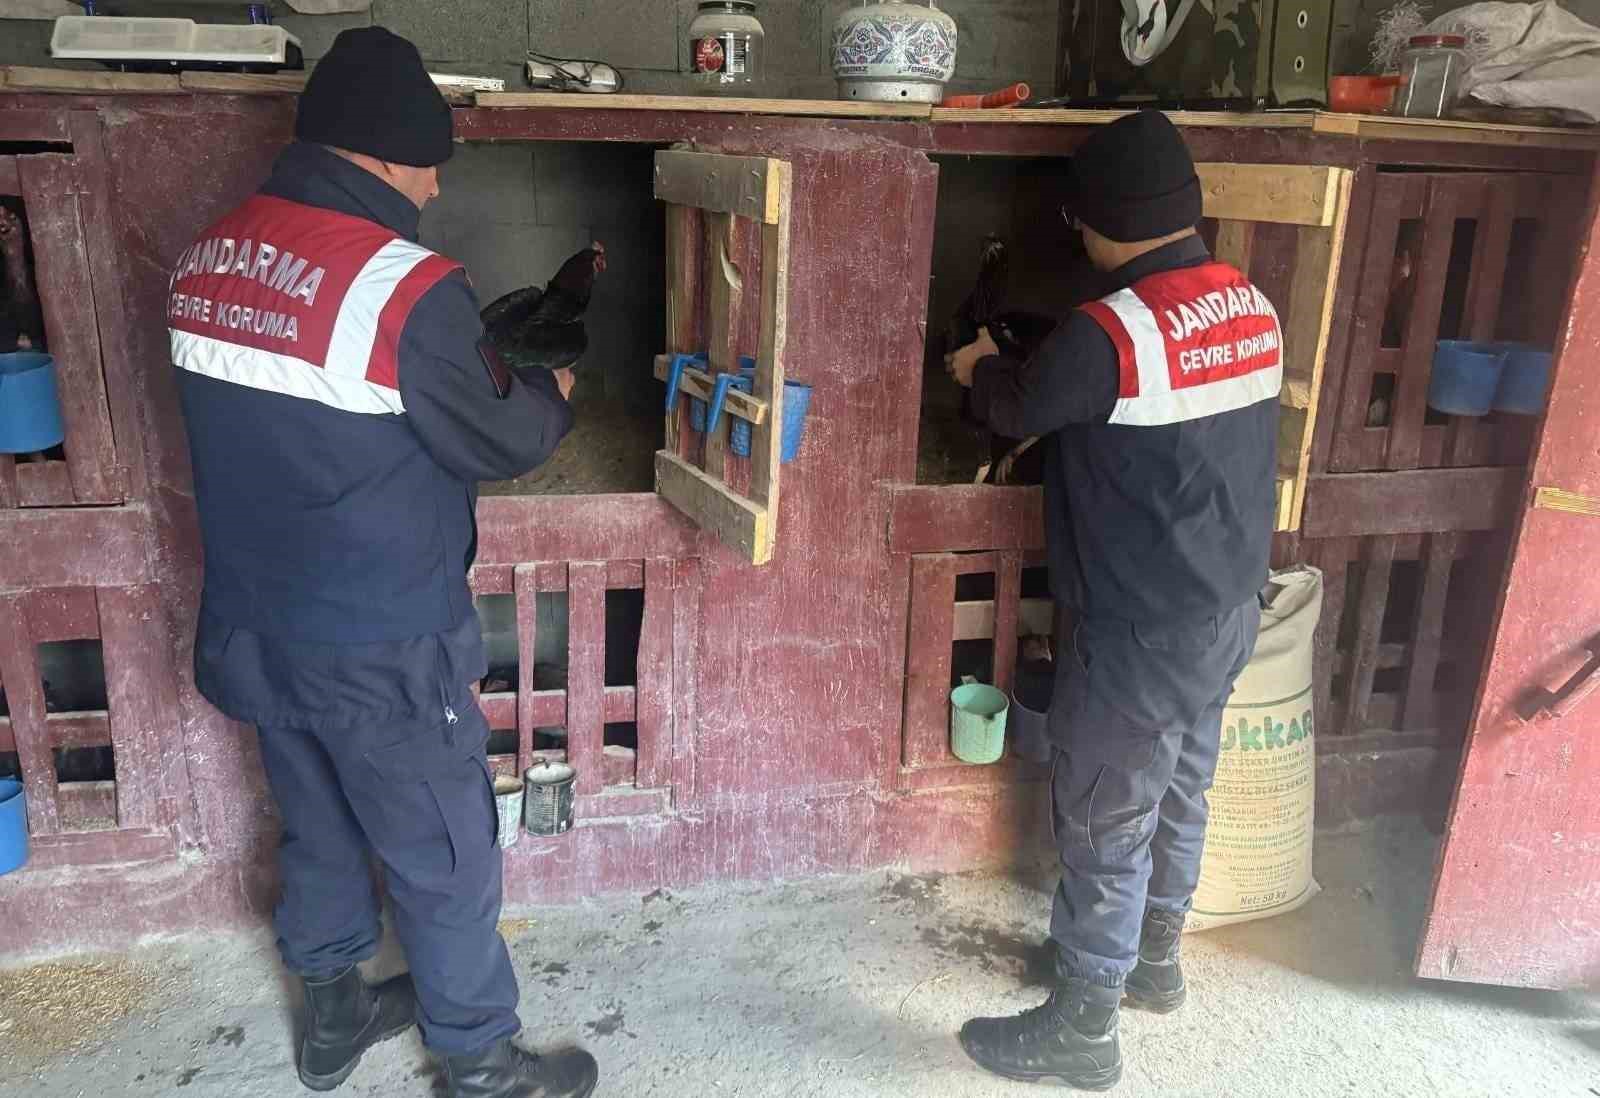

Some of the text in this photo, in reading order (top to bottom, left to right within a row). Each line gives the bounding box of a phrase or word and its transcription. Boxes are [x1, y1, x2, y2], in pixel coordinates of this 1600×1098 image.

[214, 302, 298, 342] KORUMA
[1165, 285, 1276, 341] JANDARM
[1179, 344, 1232, 374] ÇEVRE
